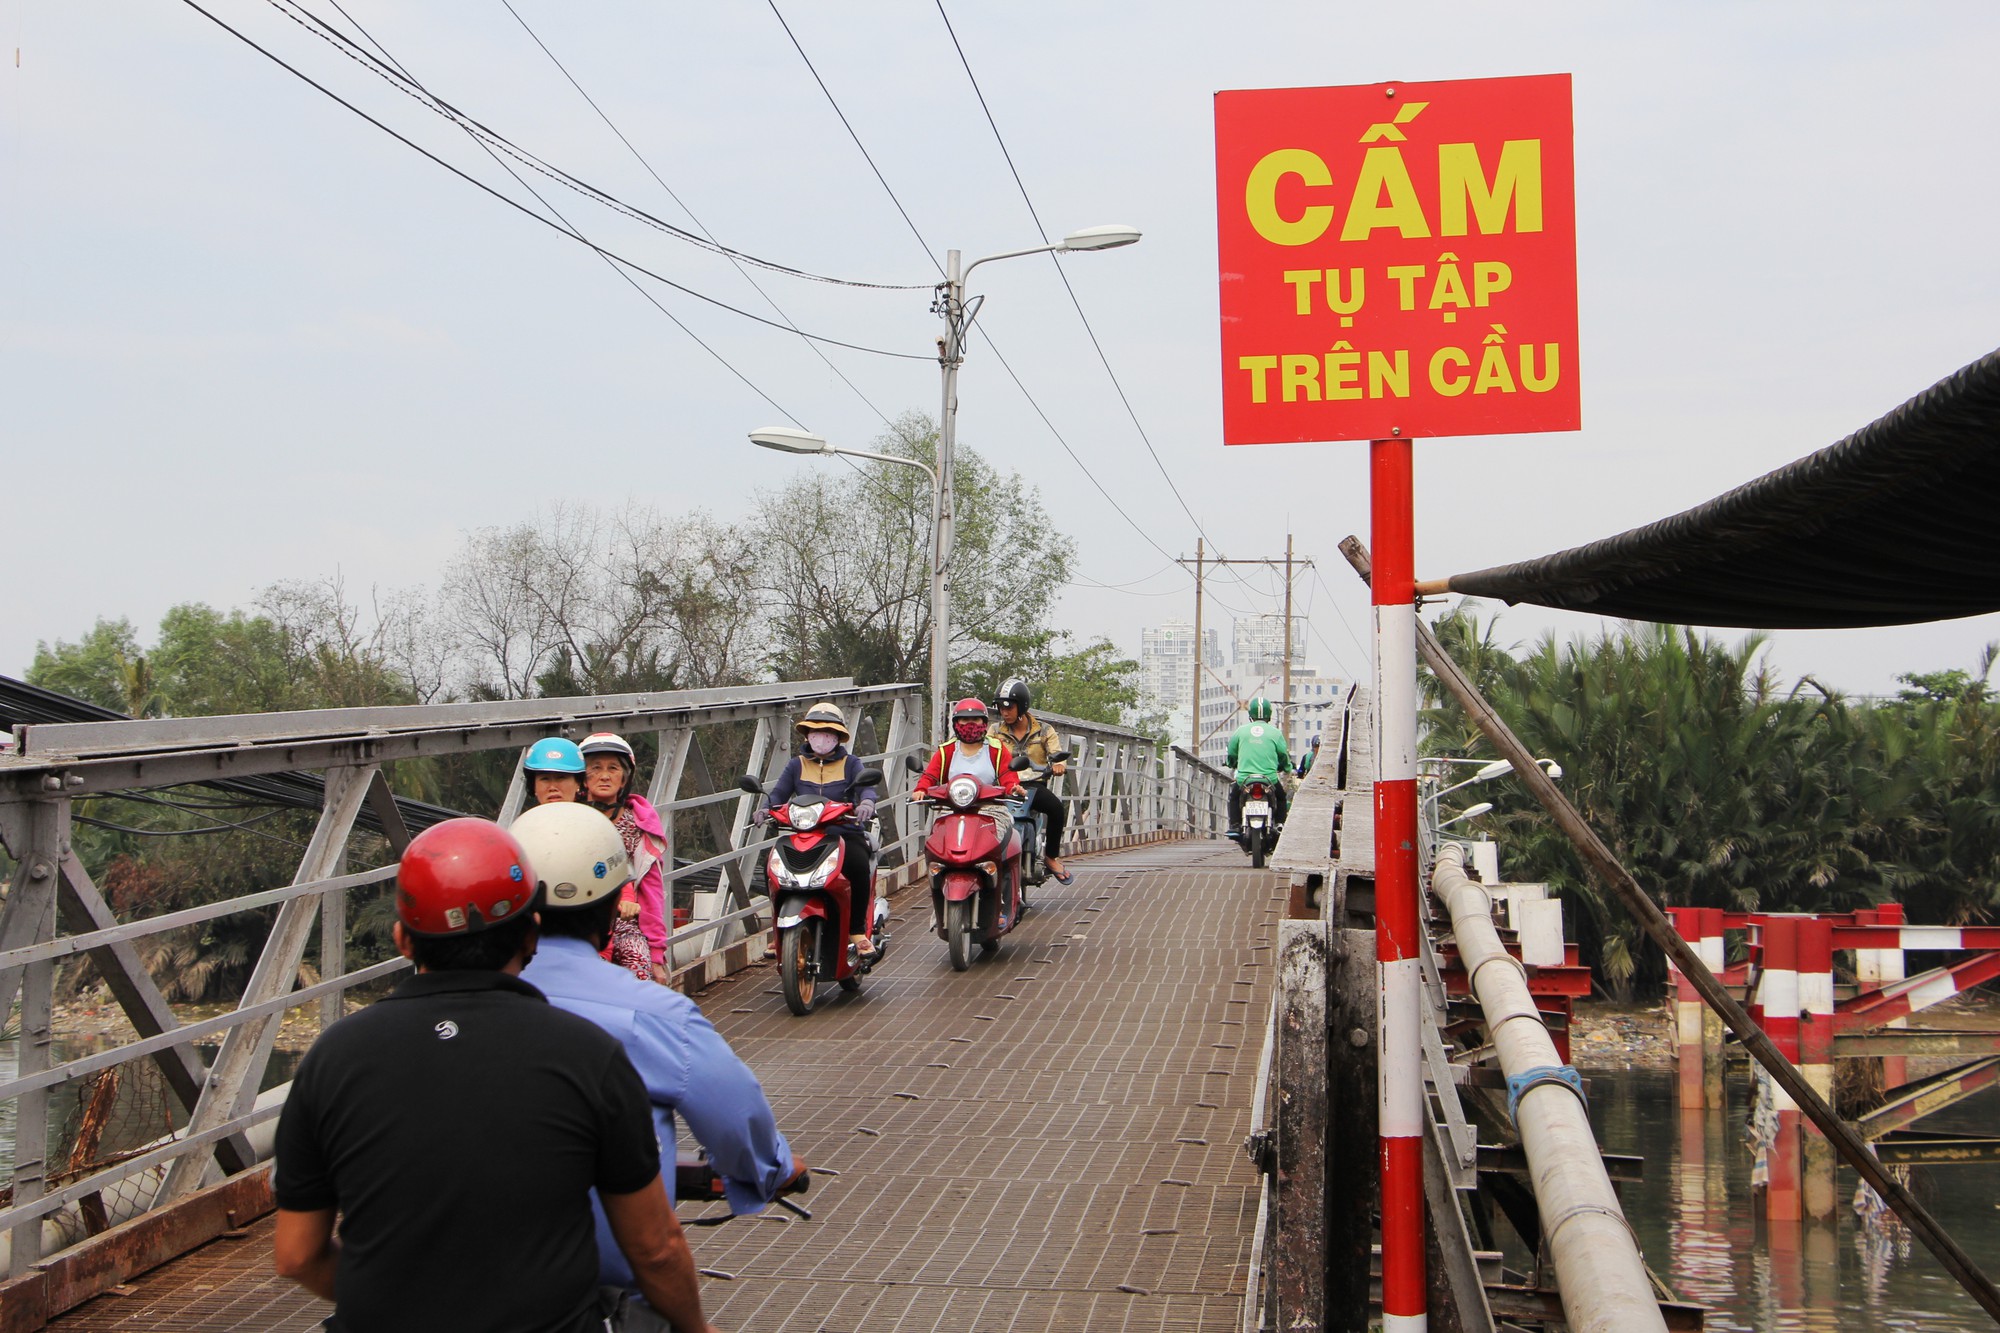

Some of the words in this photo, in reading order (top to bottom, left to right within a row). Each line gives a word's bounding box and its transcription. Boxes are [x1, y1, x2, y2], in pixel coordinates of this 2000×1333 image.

[1245, 101, 1544, 246] CẤM
[1283, 267, 1366, 328] TỤ
[1387, 252, 1513, 324] TẬP
[1239, 340, 1411, 404] TRÊN
[1428, 323, 1561, 398] CẦU
